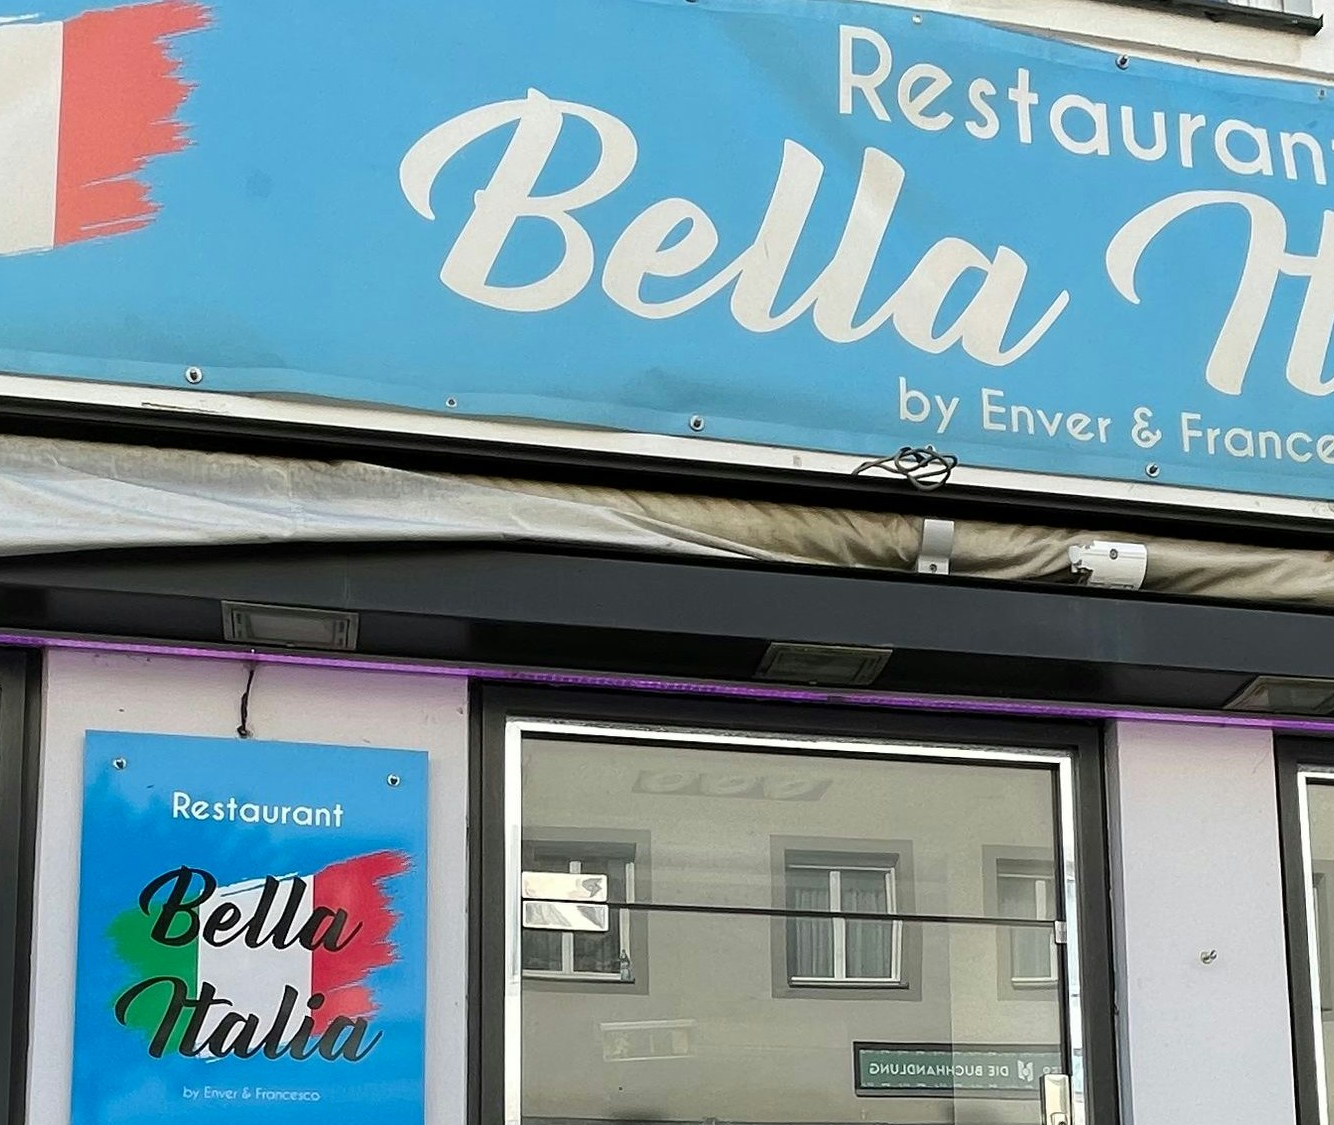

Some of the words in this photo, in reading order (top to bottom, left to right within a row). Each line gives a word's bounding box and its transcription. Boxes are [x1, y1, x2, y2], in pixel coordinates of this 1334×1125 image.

[399, 87, 1070, 367] Bella
[898, 376, 960, 434] by
[982, 387, 1112, 444] Enver
[1131, 405, 1162, 449] &
[172, 791, 344, 828] Restaurant
[138, 864, 364, 953] Bella
[113, 975, 384, 1062] Italia
[183, 1086, 200, 1101] by
[203, 1086, 238, 1100] Enver
[255, 1087, 321, 1101] Francesco
